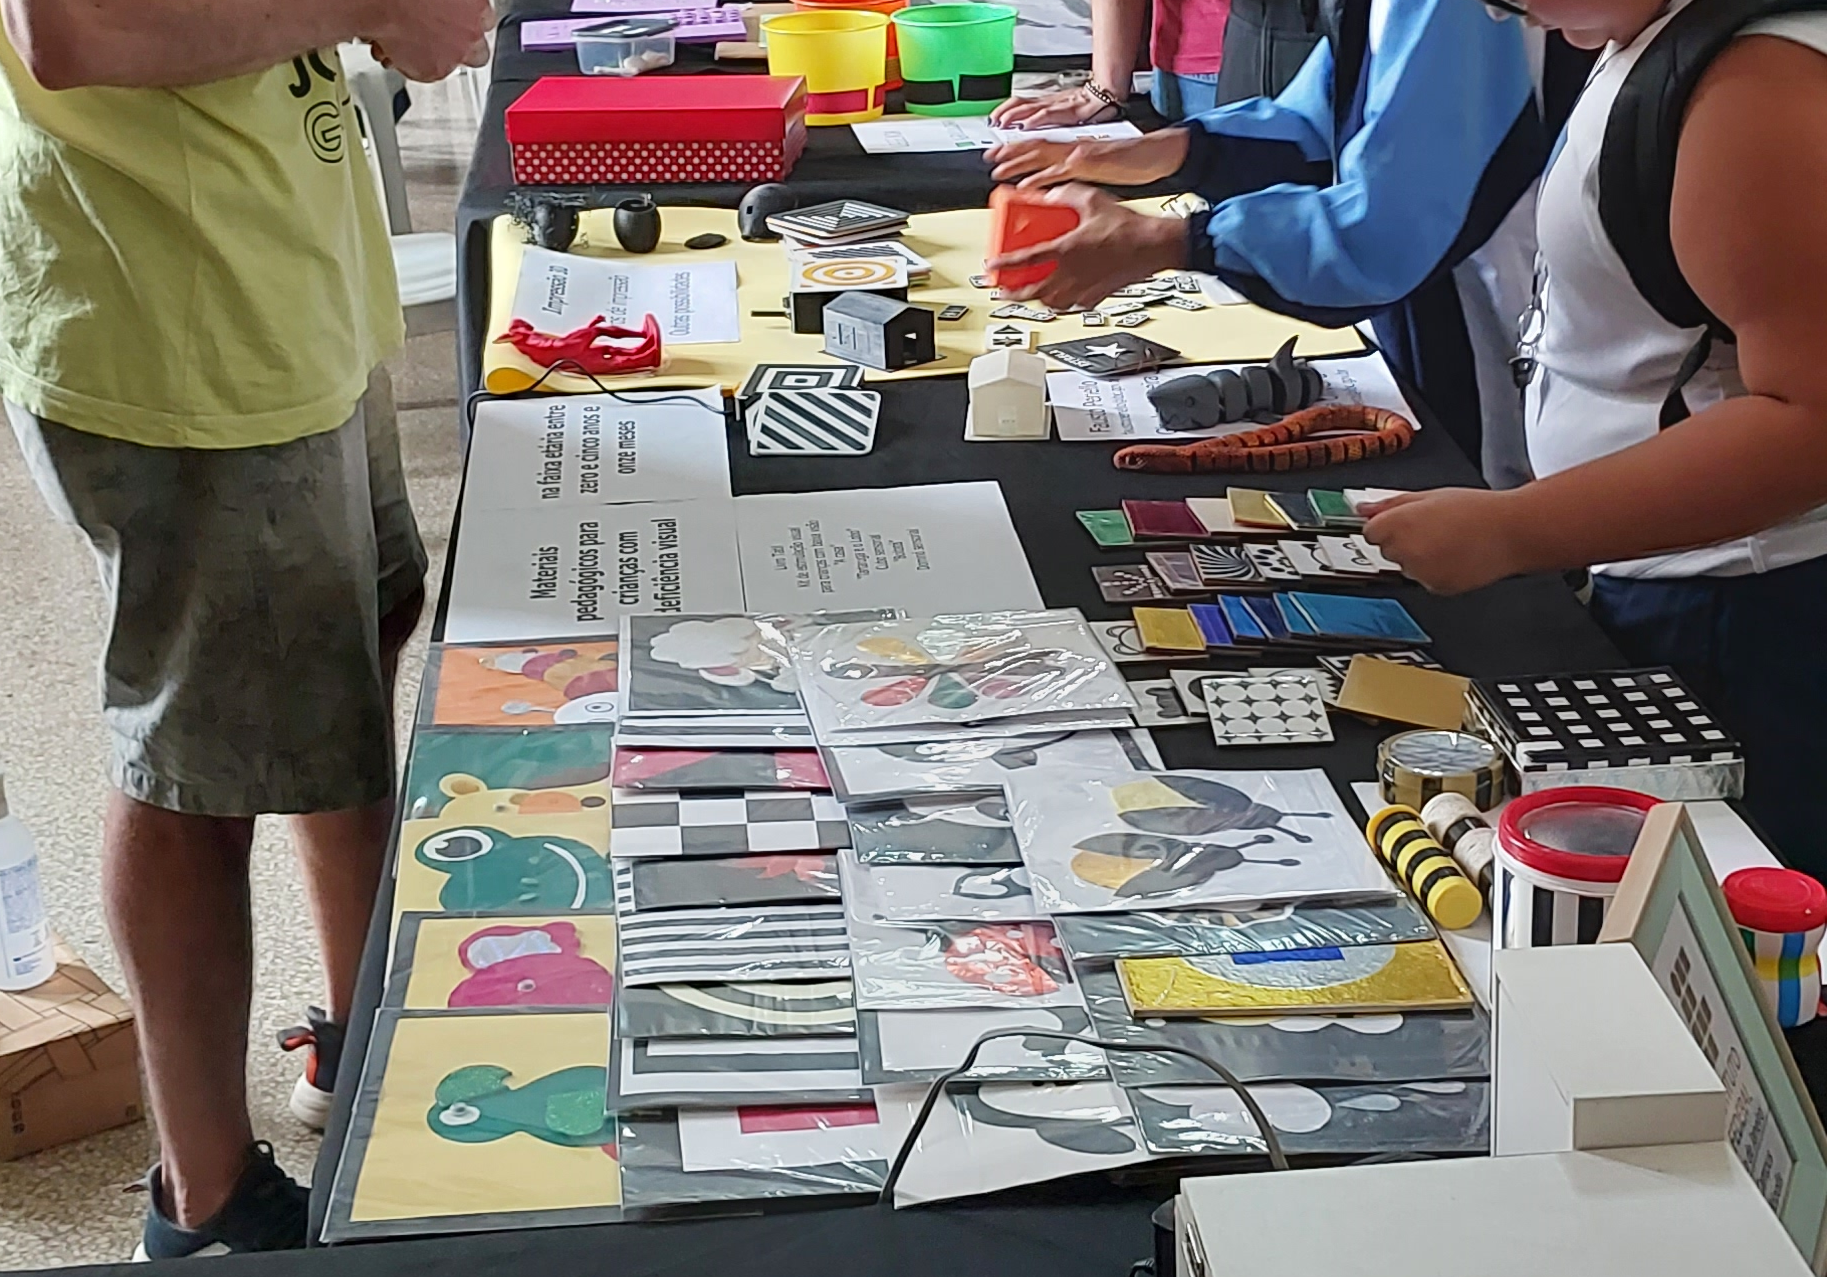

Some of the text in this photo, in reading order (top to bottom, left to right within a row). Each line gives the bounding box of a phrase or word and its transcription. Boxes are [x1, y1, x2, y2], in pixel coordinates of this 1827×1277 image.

[542, 276, 569, 315] Impressão
[609, 275, 632, 305] impressão
[669, 272, 695, 336] Outras possibilidades
[582, 414, 600, 435] anos
[1085, 409, 1110, 432] Fausto
[536, 404, 566, 499] na faixa etária entre
[575, 437, 600, 462] cinco
[616, 420, 636, 474] onze meses
[579, 472, 600, 494] zero
[650, 518, 678, 548] visual
[530, 546, 559, 599] Materiais
[569, 522, 604, 622] pedagógicos para
[612, 531, 645, 605] crianças com
